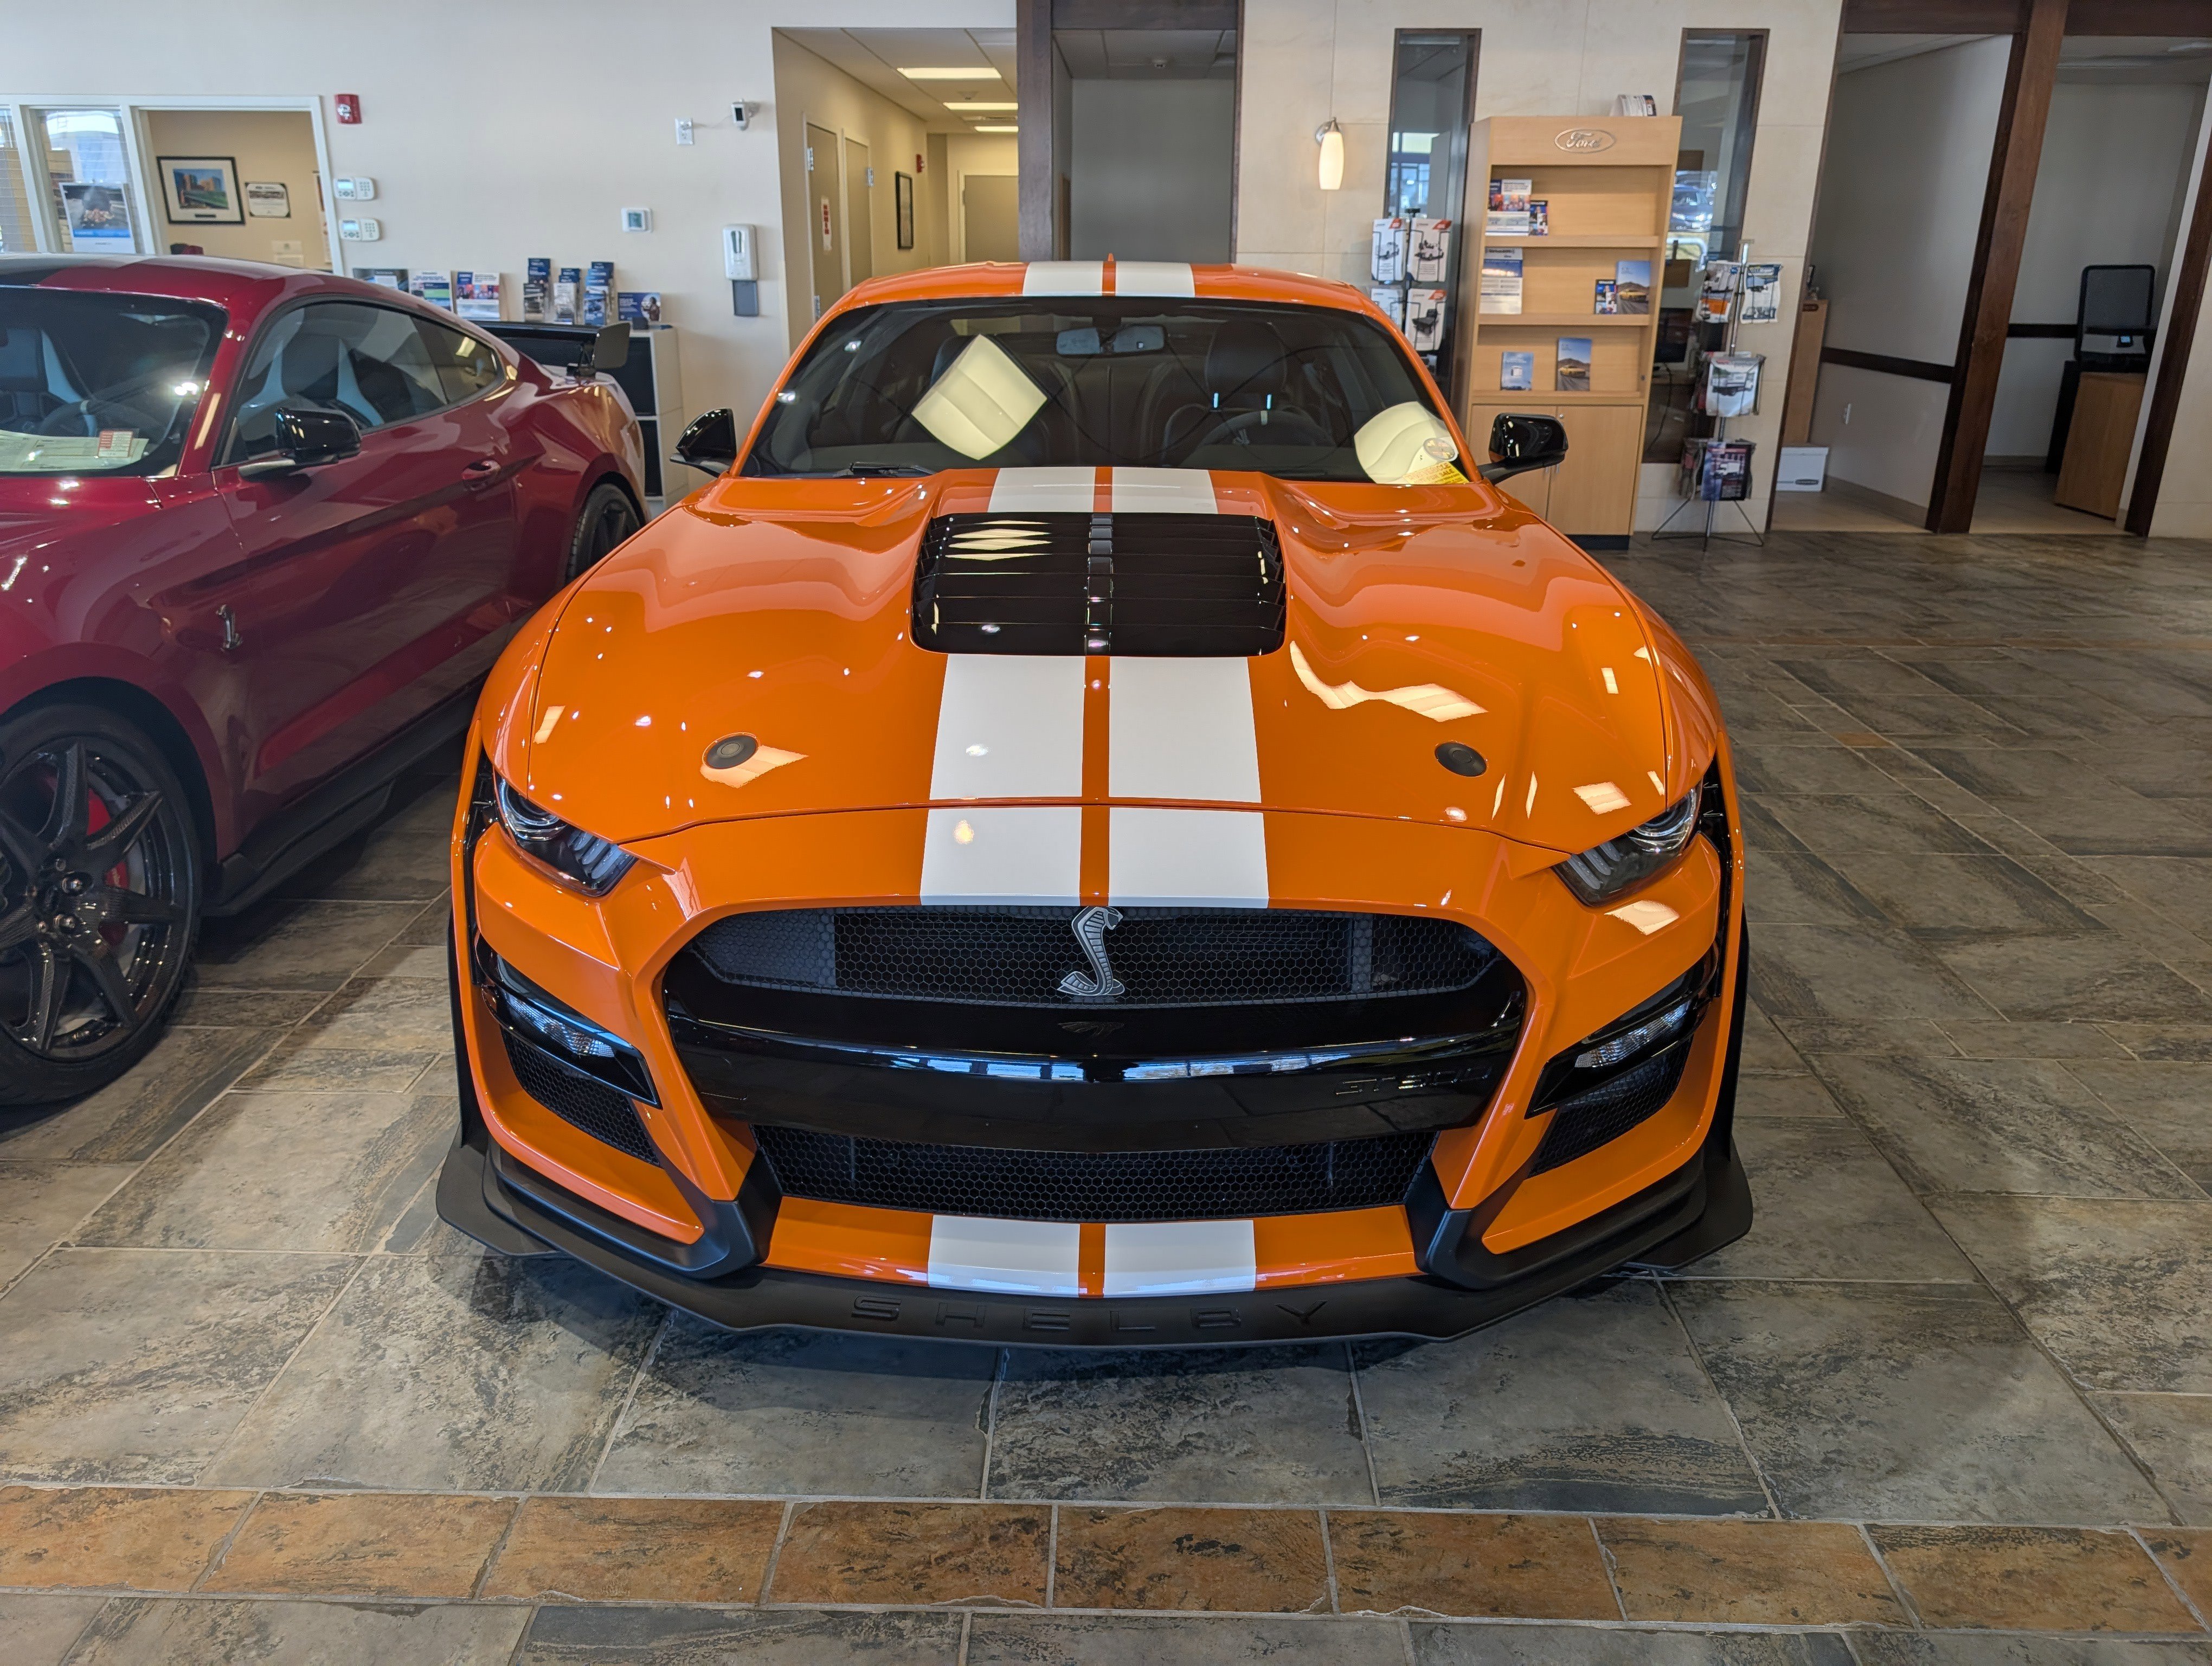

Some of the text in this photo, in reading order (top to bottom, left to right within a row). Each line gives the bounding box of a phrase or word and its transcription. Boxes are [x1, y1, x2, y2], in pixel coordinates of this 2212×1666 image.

[1566, 131, 1603, 148] Ford
[1423, 462, 1451, 475] VEHICLE
[1439, 469, 1455, 477] SALE
[1335, 1067, 1492, 1094] GT500
[851, 1295, 1328, 1330] SHELBY
